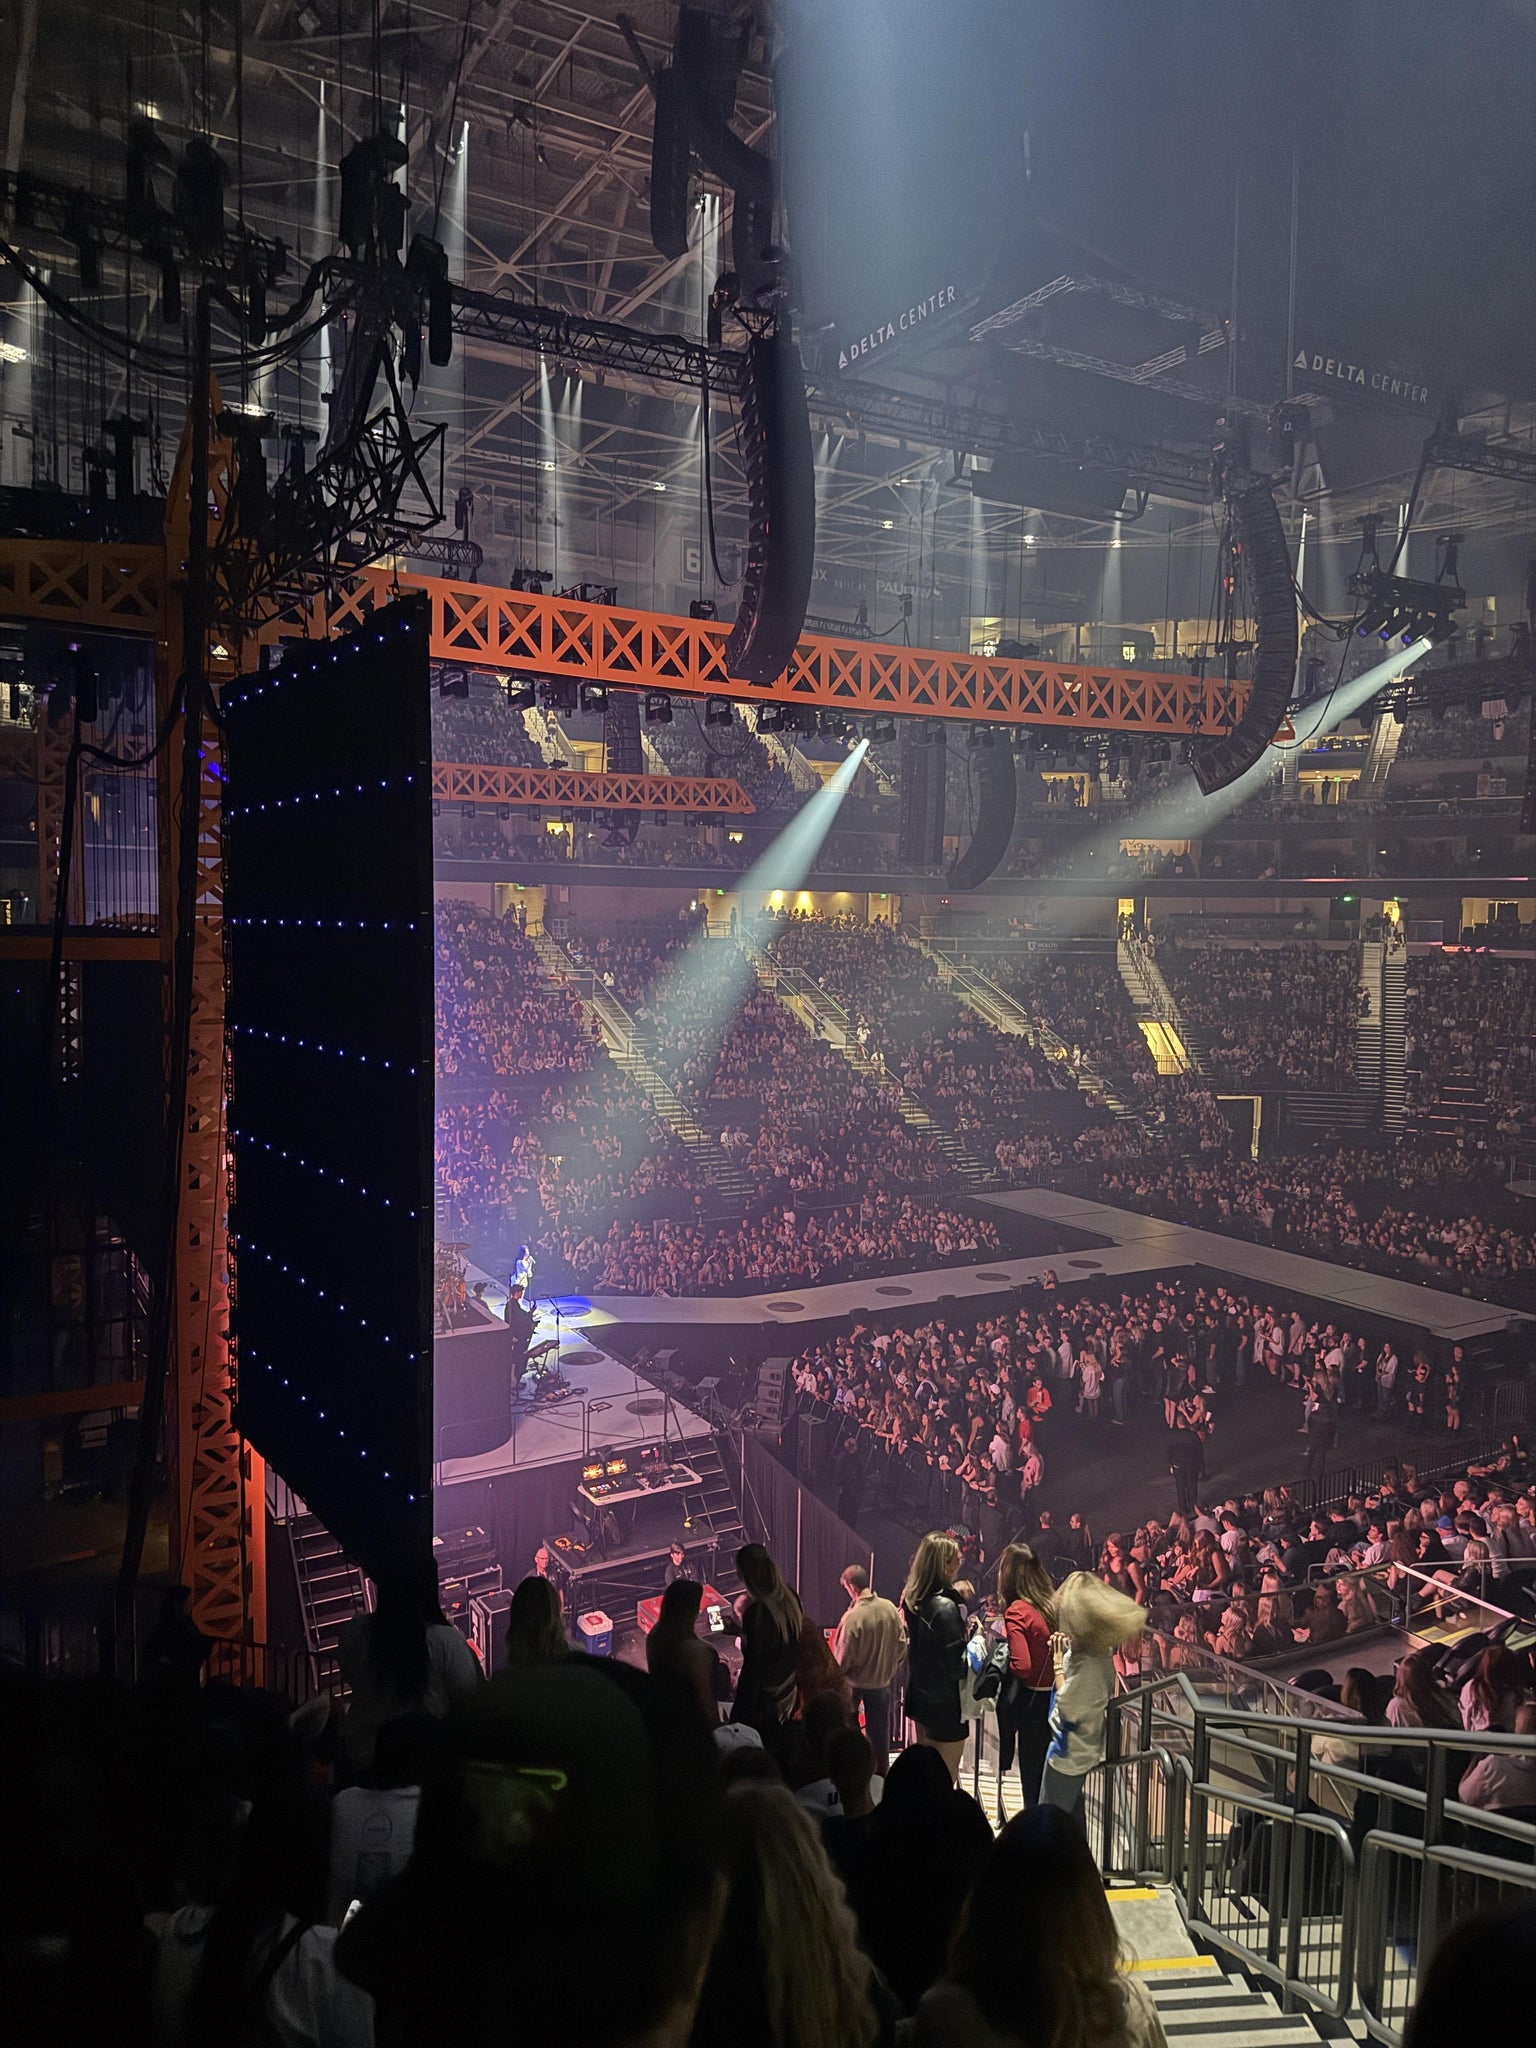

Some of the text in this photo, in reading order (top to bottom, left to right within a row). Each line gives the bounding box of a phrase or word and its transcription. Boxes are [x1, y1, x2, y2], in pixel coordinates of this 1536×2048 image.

[850, 285, 956, 360] DELTA CENTER
[1312, 354, 1428, 404] DELTA CENTER
